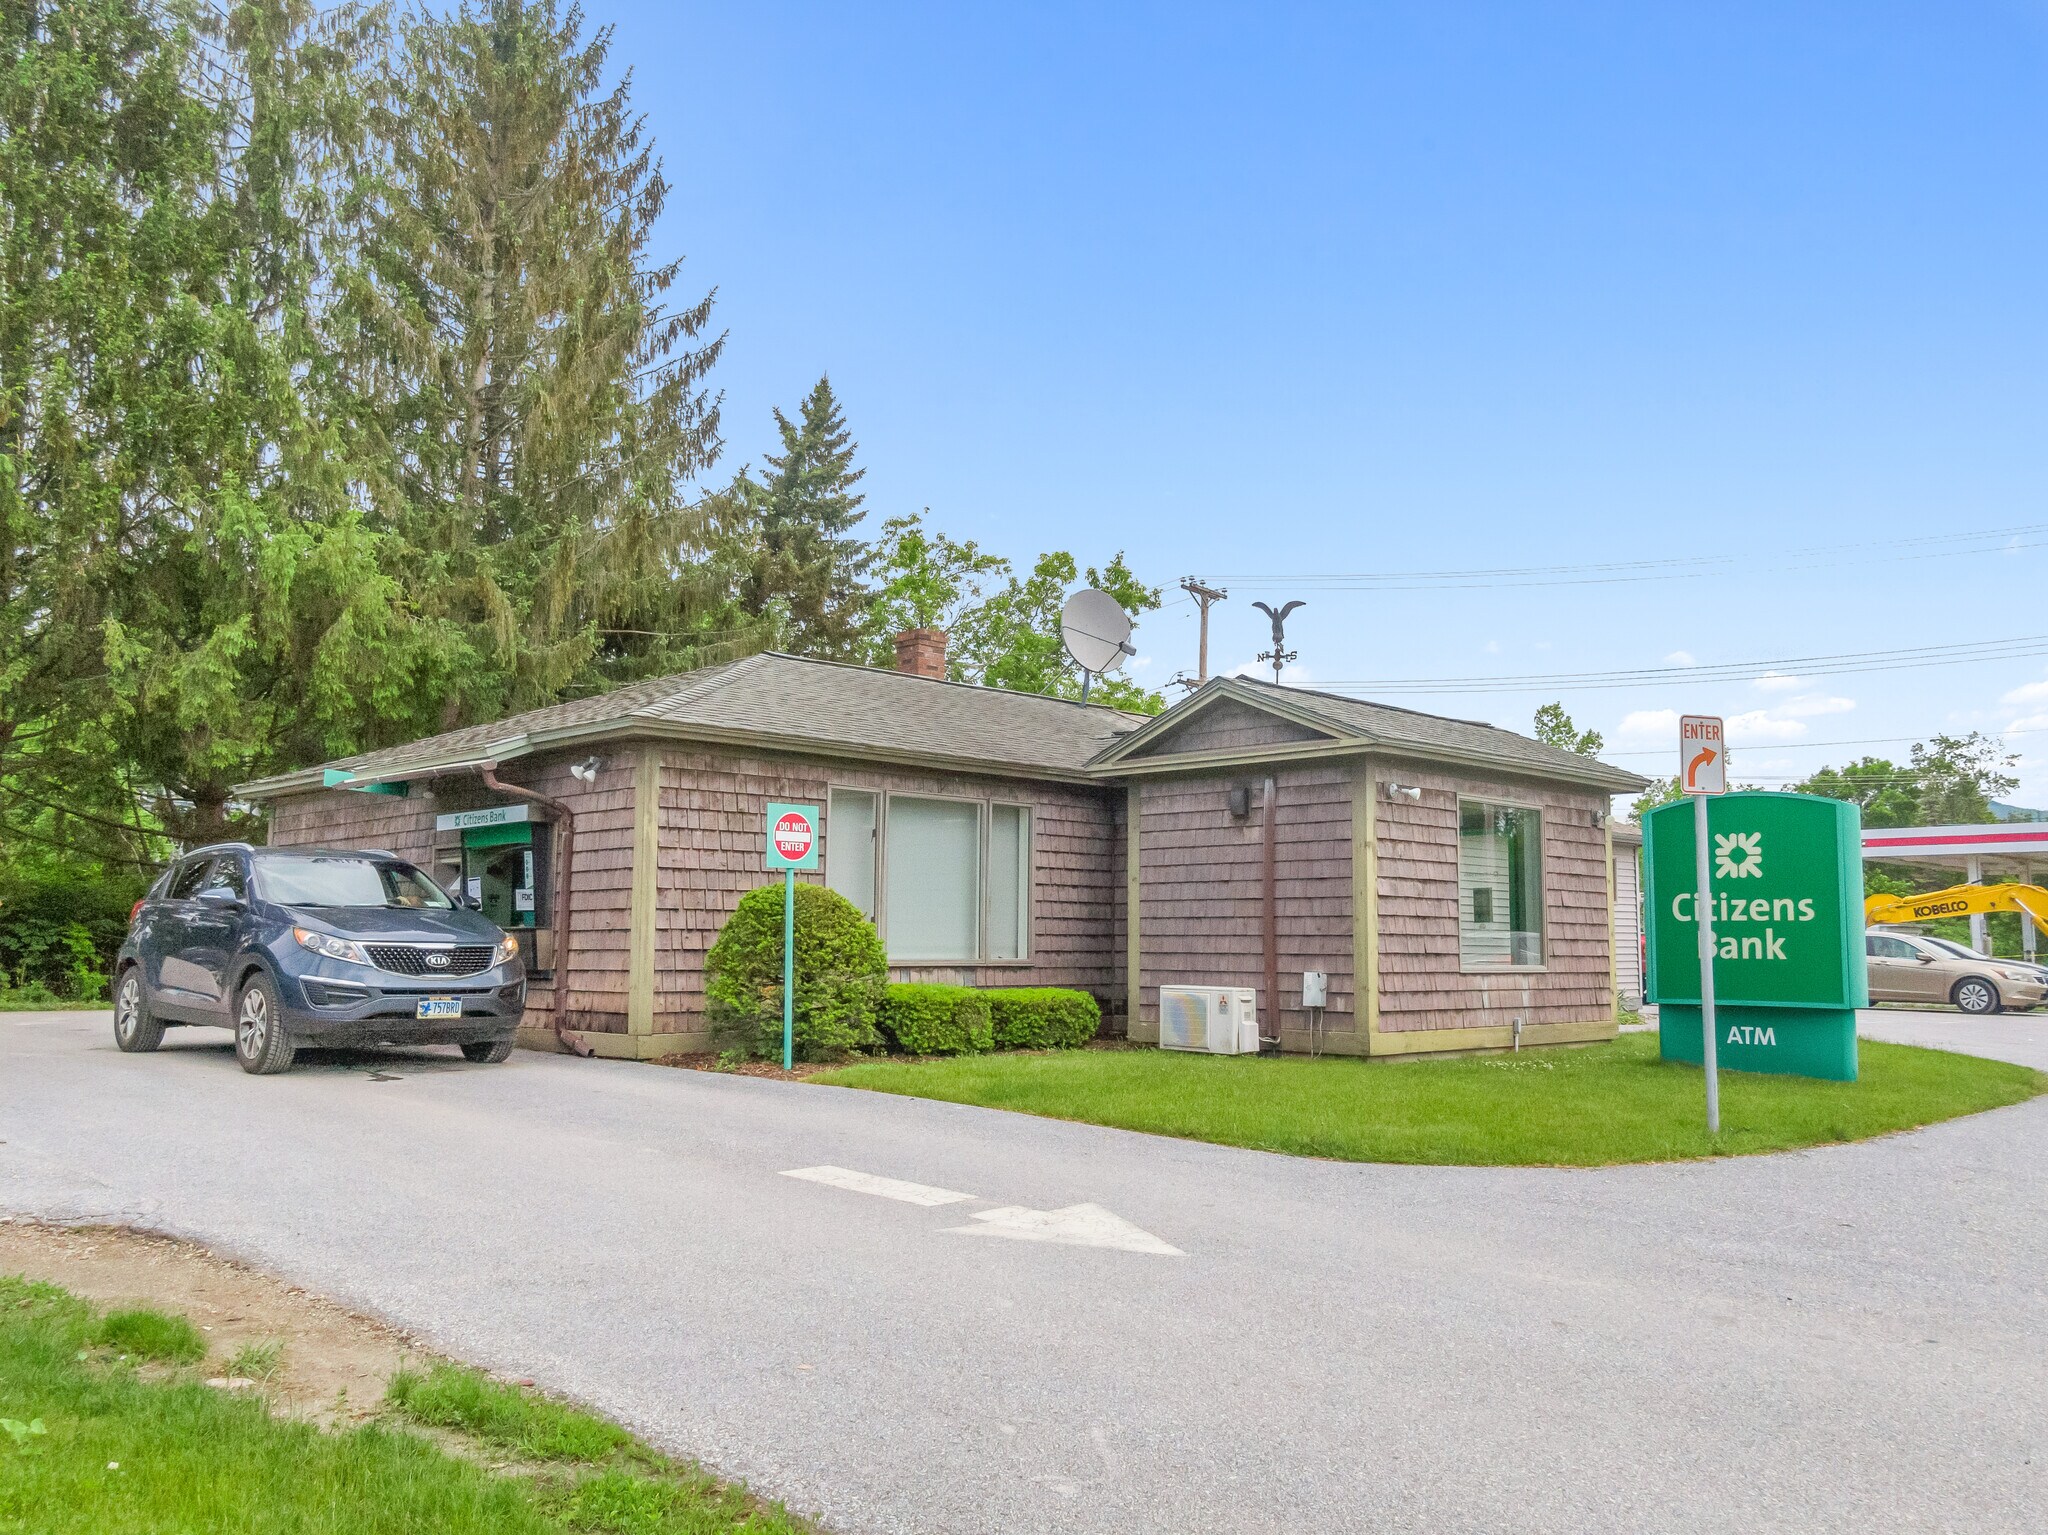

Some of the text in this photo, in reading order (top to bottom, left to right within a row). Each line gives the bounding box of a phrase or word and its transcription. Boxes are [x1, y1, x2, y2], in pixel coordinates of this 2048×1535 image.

[1683, 723, 1720, 740] ENTER
[463, 809, 506, 826] Citizens Bank
[779, 821, 807, 832] DO NOT
[781, 841, 804, 852] ENTER
[521, 893, 533, 901] FDIC
[1672, 892, 1815, 922] Citizens
[1913, 900, 1968, 918] KOBELCO
[430, 957, 447, 965] KIA
[1726, 1025, 1777, 1046] ATM
